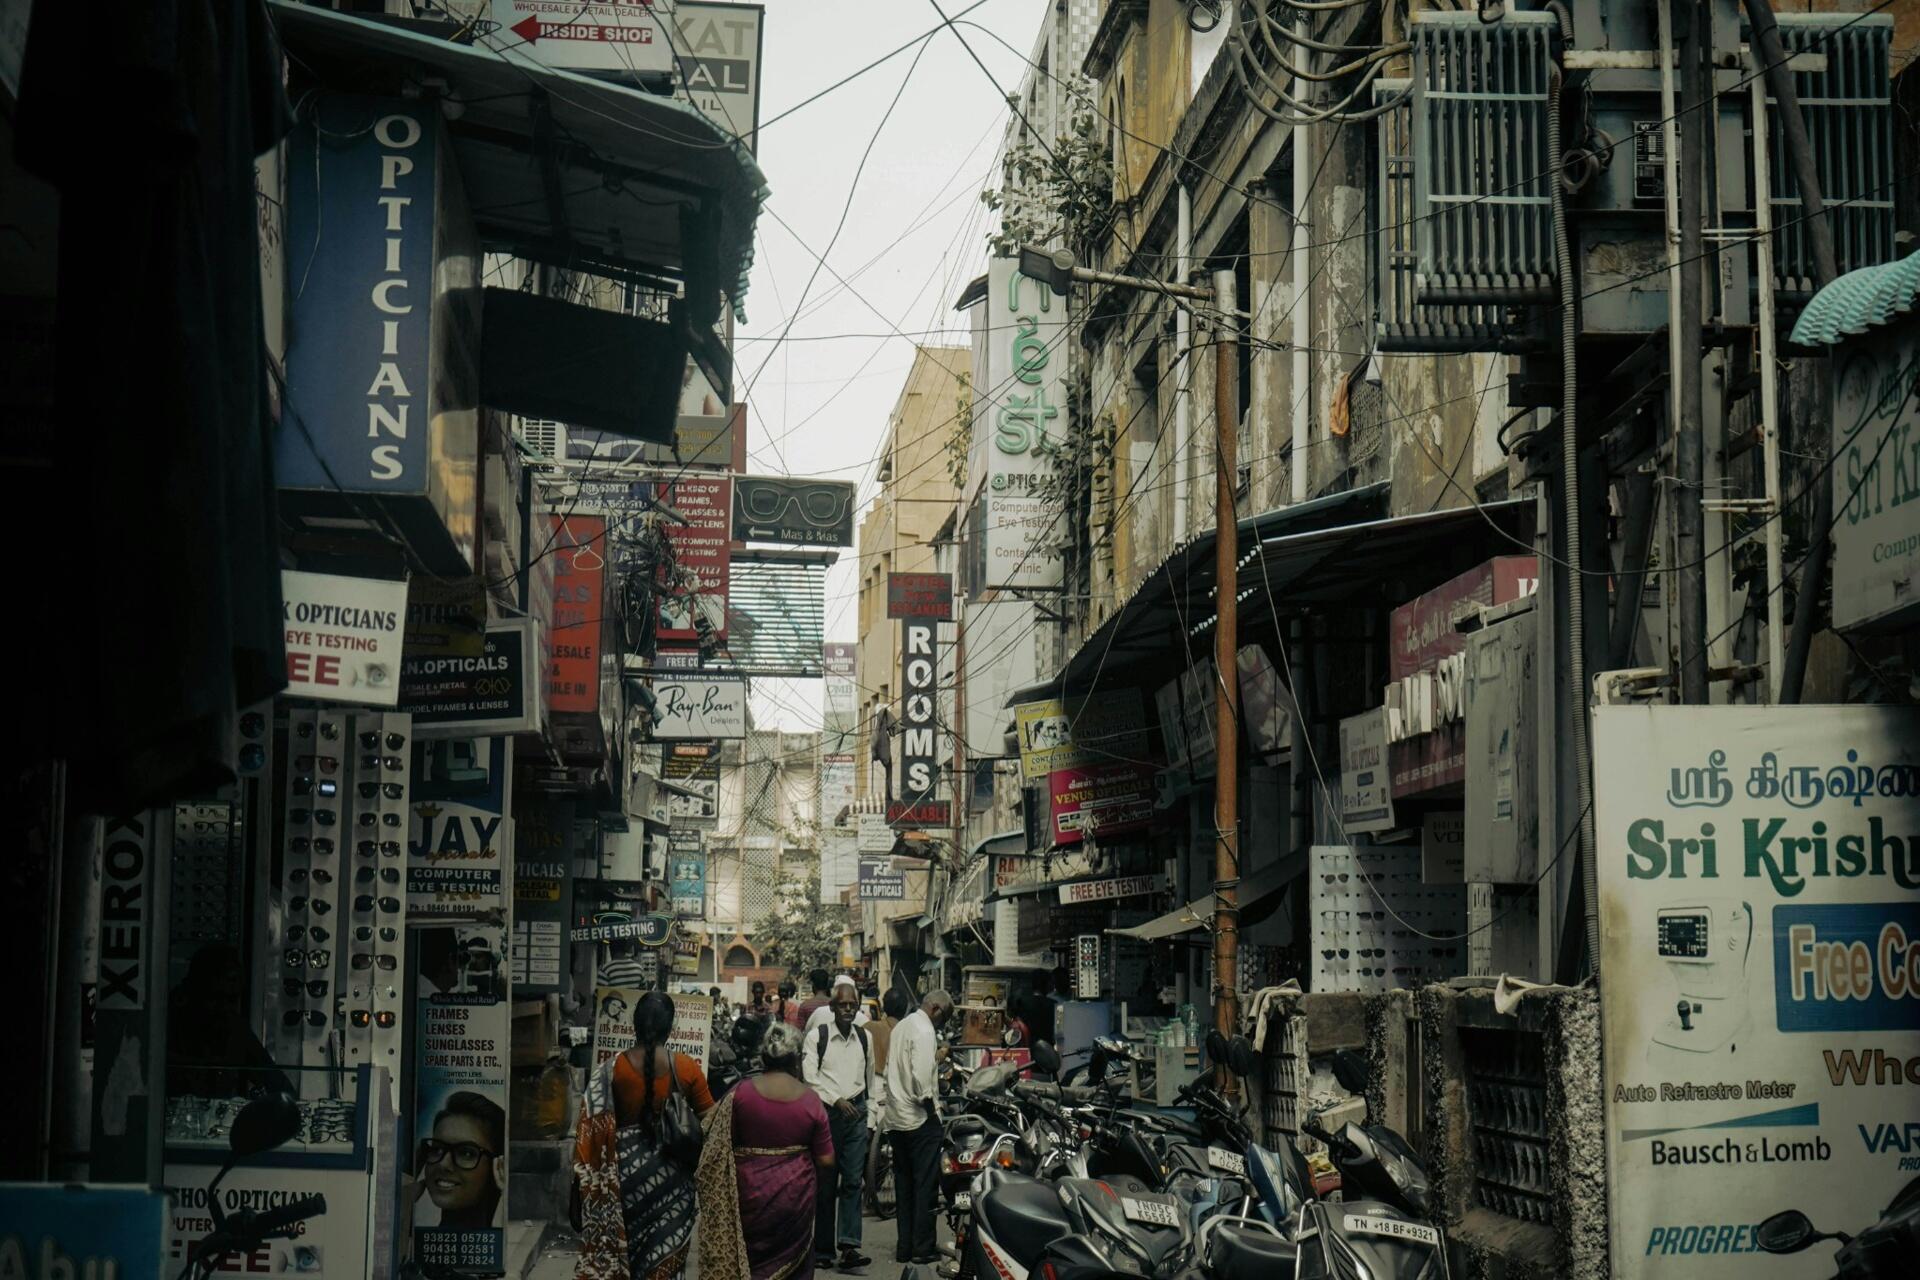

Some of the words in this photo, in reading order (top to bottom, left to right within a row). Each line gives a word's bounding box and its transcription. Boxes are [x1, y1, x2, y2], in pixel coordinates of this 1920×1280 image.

[514, 3, 571, 14] WHOLESALE
[574, 6, 582, 15] &
[584, 6, 612, 17] RETAIL
[540, 23, 600, 41] INSIDE
[604, 26, 652, 44] SHOP
[366, 113, 422, 481] OPTICIANS
[1846, 440, 1884, 526] Sri
[998, 516, 1017, 530] Eye
[1021, 517, 1056, 531] Testing
[683, 538, 724, 546] COMPUTER
[780, 529, 803, 541] Mas
[806, 531, 813, 540] &
[816, 531, 839, 541] Mas
[1013, 562, 1042, 574] Clinic
[295, 602, 396, 632] OPTICIANS
[286, 631, 311, 645] EYE
[316, 633, 378, 652] TESTING
[666, 657, 686, 667] FREE
[432, 702, 466, 713] FRAMES
[477, 700, 509, 710] LENSES
[904, 626, 933, 792] ROOMS
[1666, 748, 1734, 809] ஸ்ரீ
[1055, 788, 1096, 805] VENUS
[408, 815, 502, 857] JAY
[1626, 817, 1720, 880] Sri
[414, 869, 492, 880] COMPUTER
[408, 881, 435, 891] EYE
[440, 882, 500, 893] TESTING
[873, 884, 902, 897] OPTICALS
[1070, 885, 1094, 901] FREE
[1096, 882, 1112, 898] EYE
[1115, 877, 1154, 896] TESTING
[101, 811, 144, 1003] XEROX
[571, 928, 589, 942] REE
[591, 925, 611, 940] EYE
[612, 921, 655, 938] TESTING
[1789, 924, 1873, 1002] Free
[425, 1008, 470, 1020] FRAMES
[425, 1023, 466, 1035] LENSES
[424, 1039, 495, 1051] SUNGLASSES
[597, 1036, 616, 1047] SREE
[668, 1042, 704, 1056] OPTICIANS
[424, 1055, 449, 1067] SPARE
[450, 1056, 475, 1067] PARTS
[476, 1056, 482, 1067] &
[1613, 1083, 1657, 1104] Auto
[1660, 1080, 1743, 1102] Refractro
[1745, 1078, 1797, 1101] Meter
[1651, 1137, 1742, 1166] Bausch
[1762, 1136, 1832, 1164] Lomb
[1353, 1218, 1368, 1230] TN
[1392, 1225, 1405, 1236] BF
[424, 1232, 458, 1243] 93823
[461, 1233, 496, 1244] 05782
[424, 1243, 457, 1254] 90434
[461, 1244, 494, 1255] 02581
[424, 1254, 457, 1265] 74183
[461, 1255, 496, 1265] 73824
